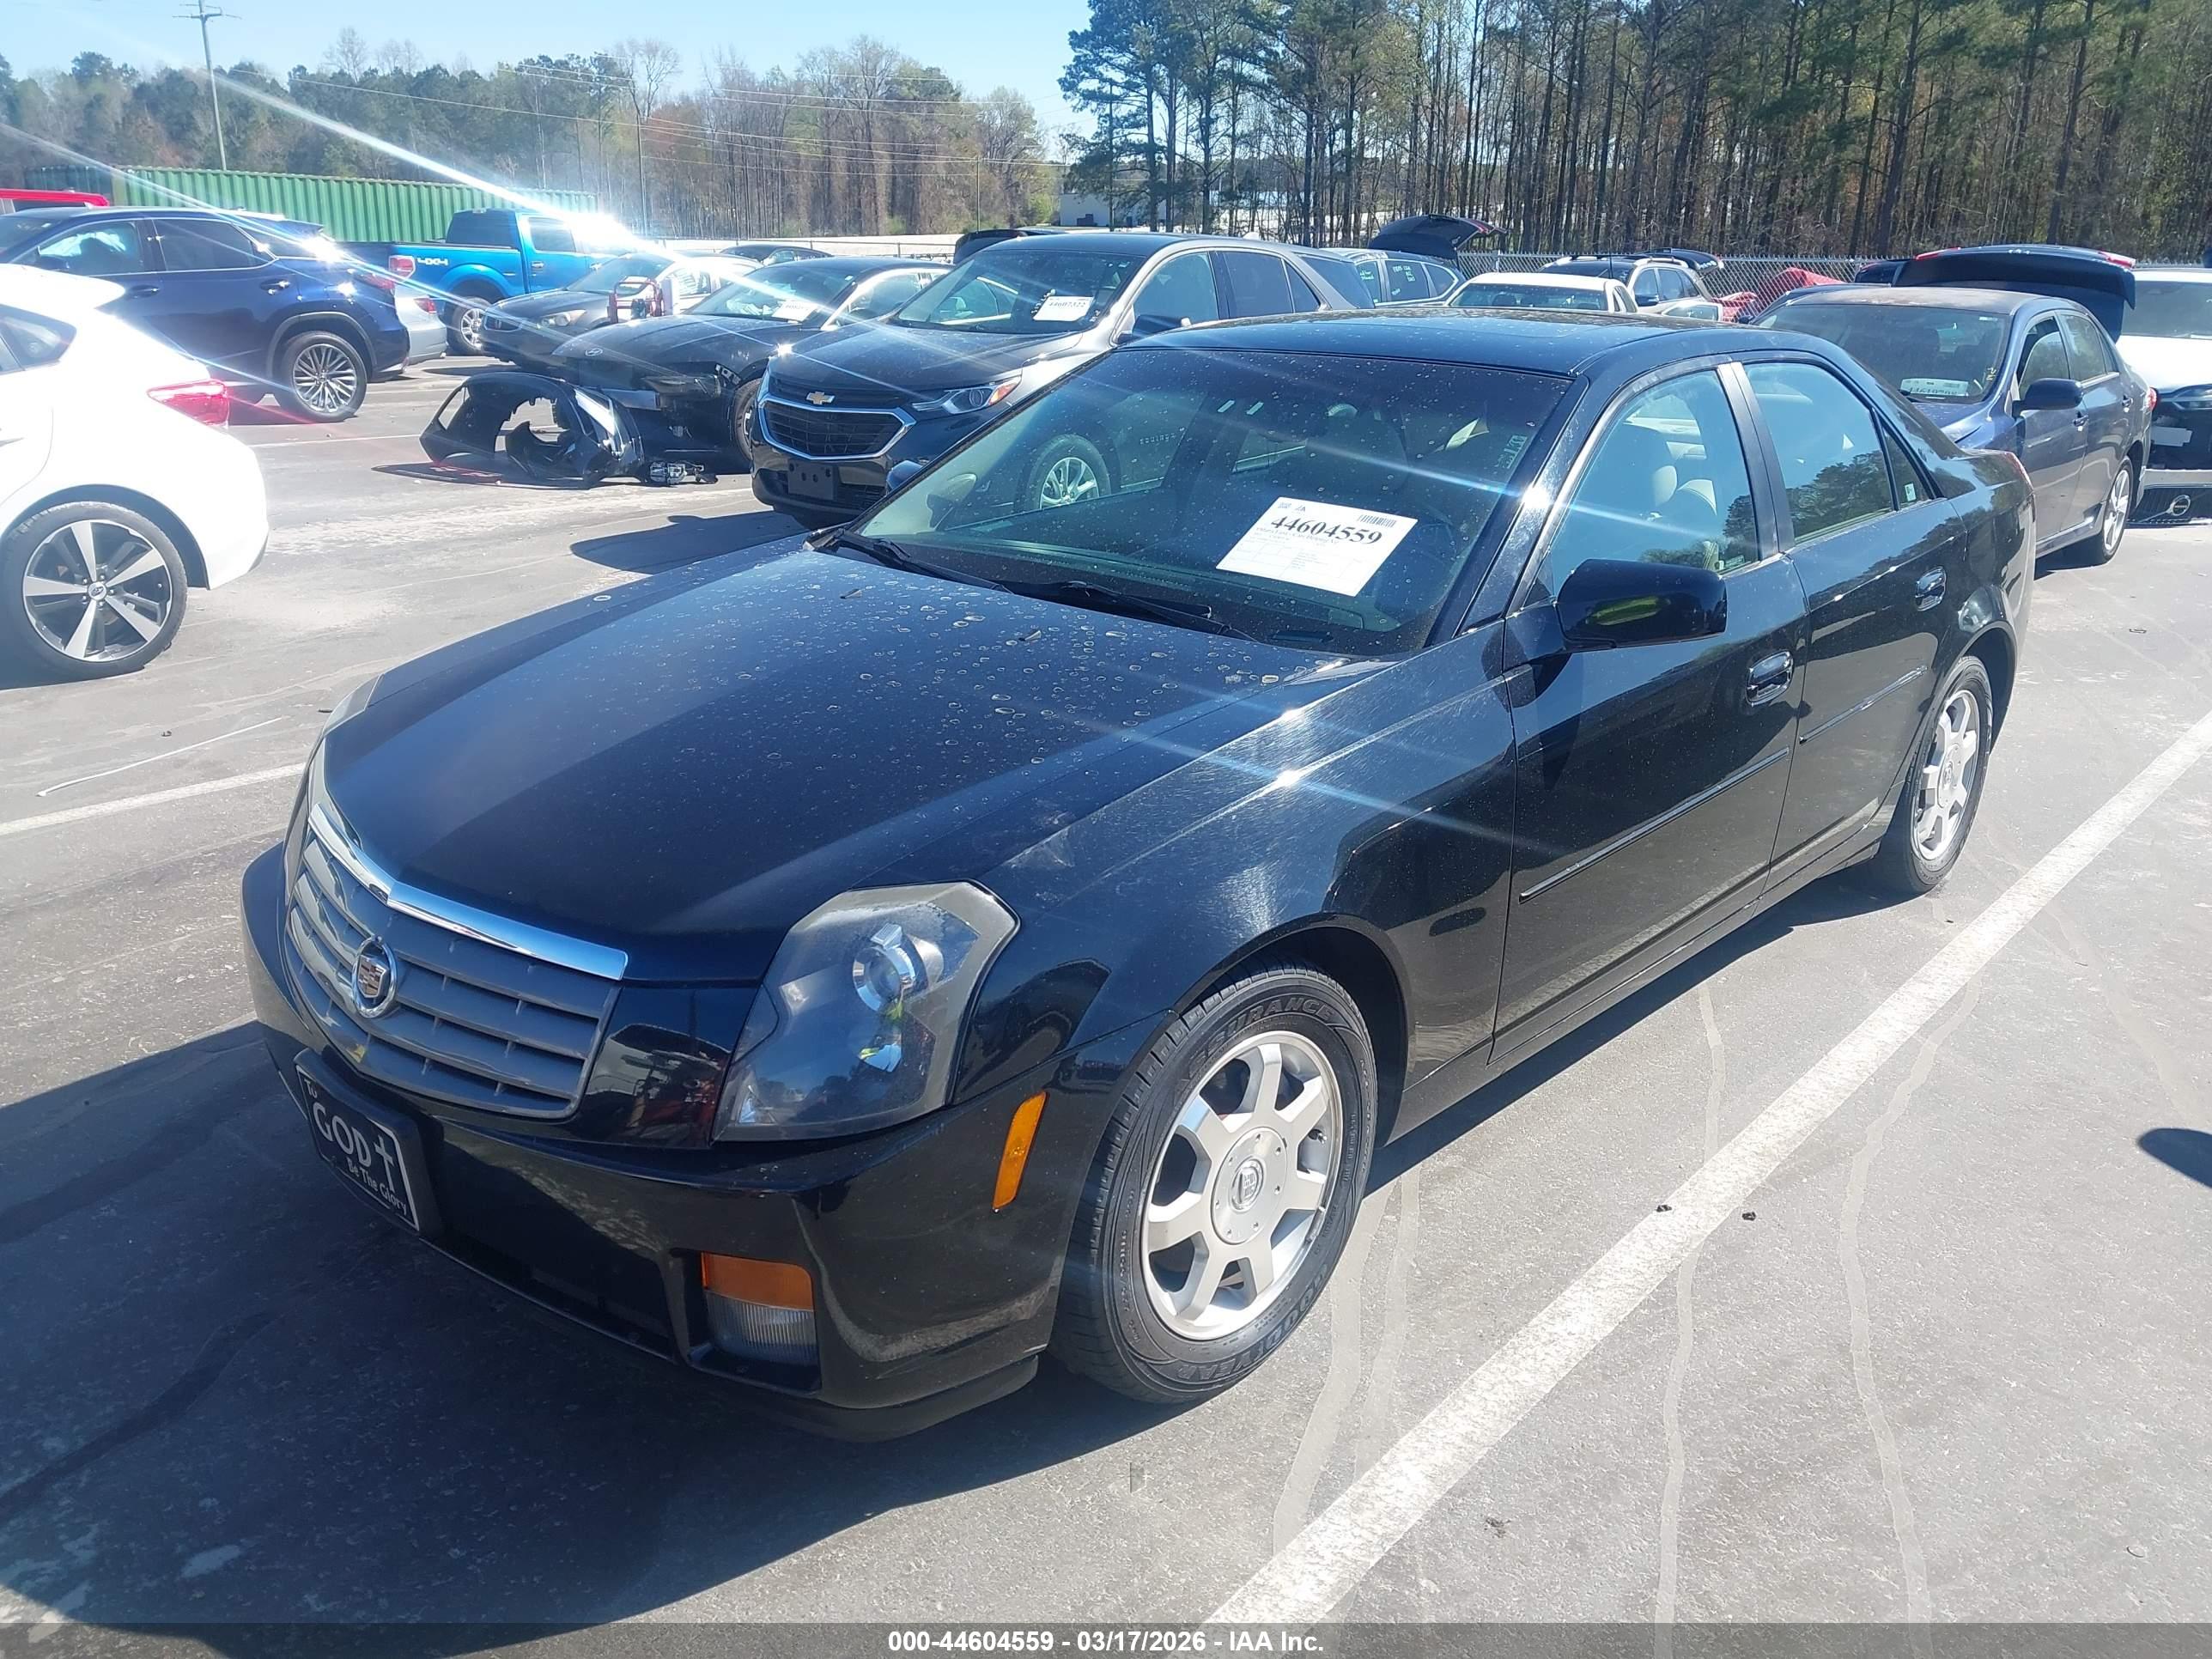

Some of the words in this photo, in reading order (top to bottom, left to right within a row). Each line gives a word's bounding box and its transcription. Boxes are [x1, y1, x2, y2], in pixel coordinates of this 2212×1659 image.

[1270, 515, 1383, 545] 44604559
[313, 1101, 372, 1168] GOD
[359, 1166, 379, 1192] The
[378, 1182, 407, 1216] Glory
[1176, 1263, 1328, 1381] GOODYEAR
